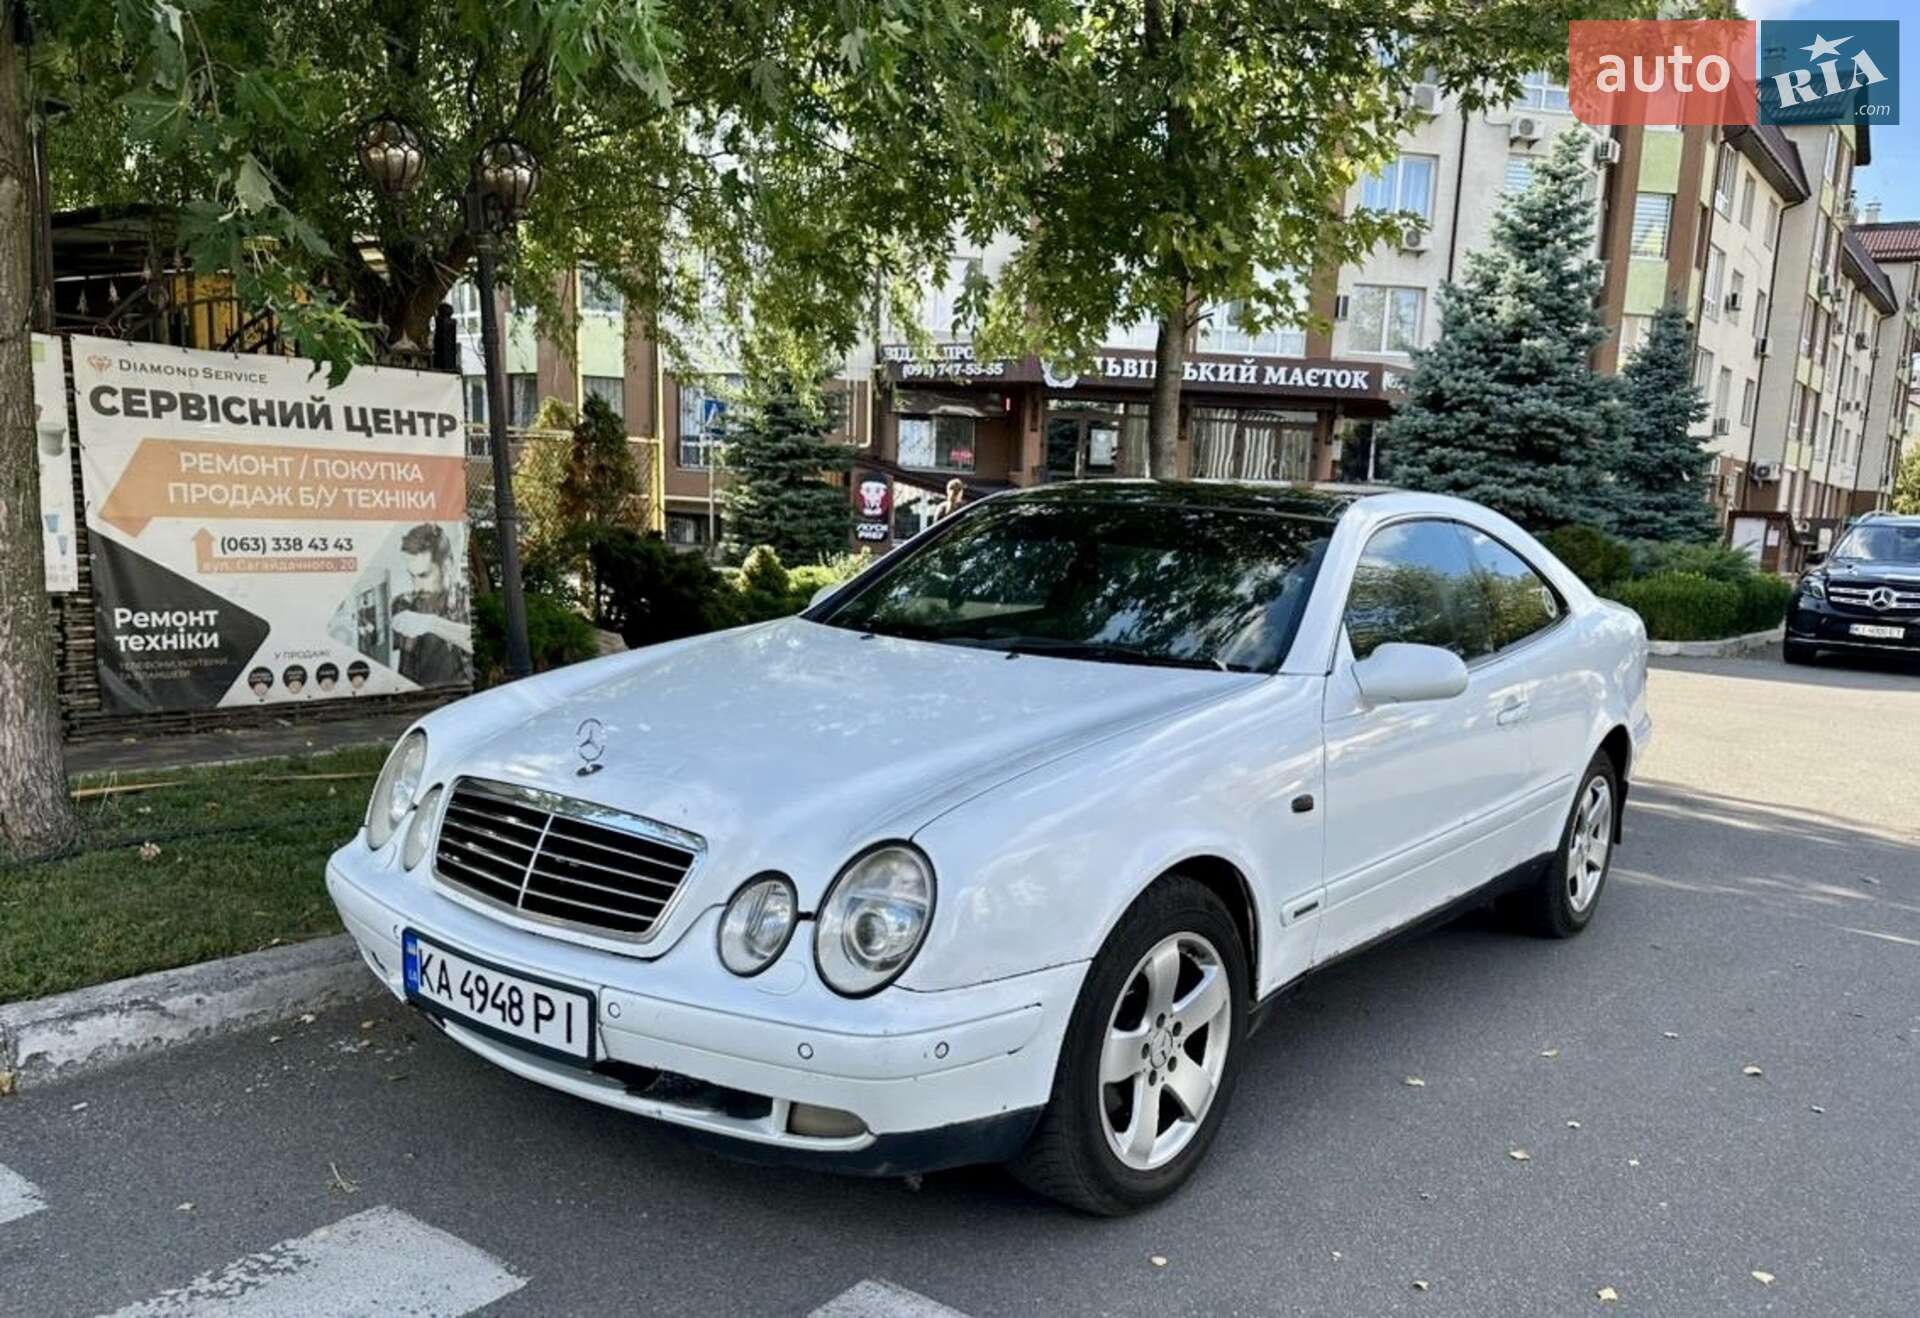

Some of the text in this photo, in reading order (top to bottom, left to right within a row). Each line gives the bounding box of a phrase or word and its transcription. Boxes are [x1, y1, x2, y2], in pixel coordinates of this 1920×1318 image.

[1262, 365, 1369, 390] МАЄТОК
[89, 385, 458, 438] СЕРВІСНИЙ ЦЕНТР
[179, 452, 294, 477] РЕМОНТ
[312, 457, 425, 483] ПОКУПКА
[167, 482, 438, 510] ПРОДАЖ Б/У ТЕХНІКИ
[220, 536, 354, 555] (063) 338 43 43
[114, 607, 219, 629] Ремонт
[114, 627, 220, 652] техніки
[460, 969, 525, 1027] 4948
